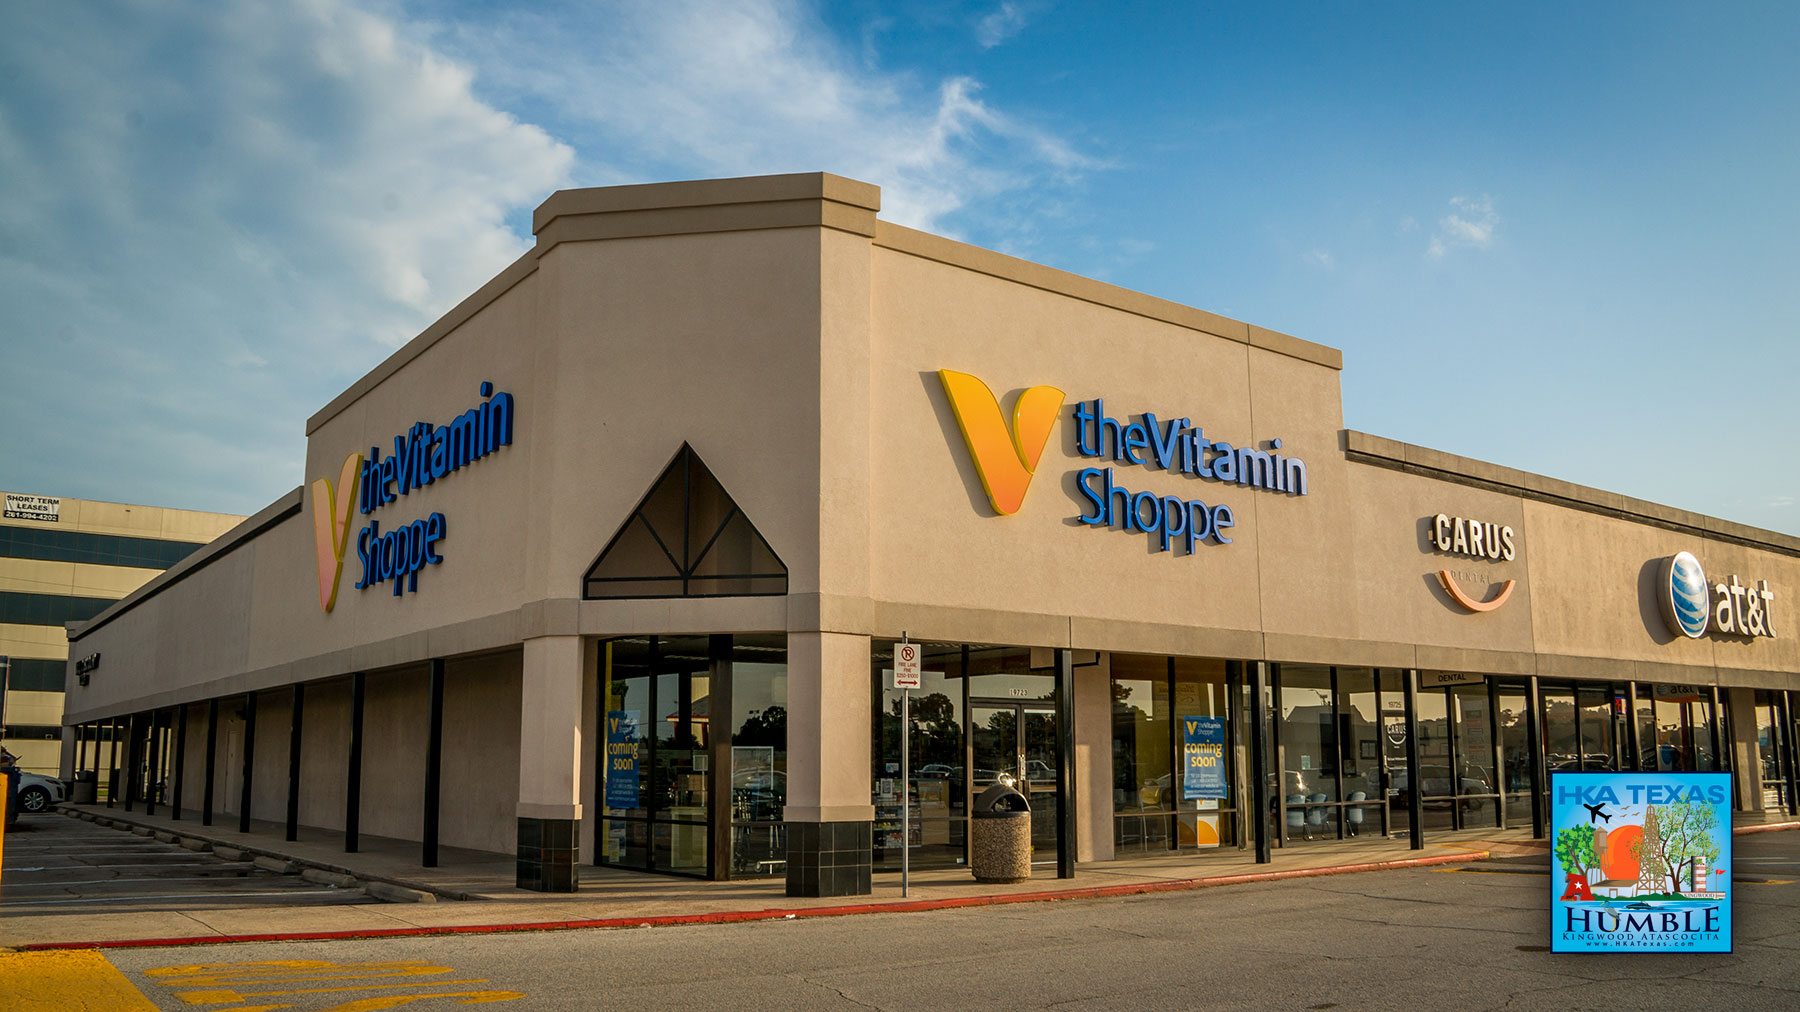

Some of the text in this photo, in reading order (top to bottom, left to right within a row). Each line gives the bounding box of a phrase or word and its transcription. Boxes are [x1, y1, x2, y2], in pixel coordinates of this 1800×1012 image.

[7, 495, 35, 503] SHORT
[17, 503, 48, 511] LEASES
[1077, 467, 1235, 555] Shoppe
[1433, 513, 1516, 561] CARUS
[355, 512, 446, 596] Shoppe
[1715, 574, 1777, 638] at&t
[1438, 673, 1466, 682] DENTAL
[608, 736, 639, 759] coming
[1184, 739, 1223, 758] coming
[613, 758, 634, 770] soon
[1191, 756, 1216, 767] soon
